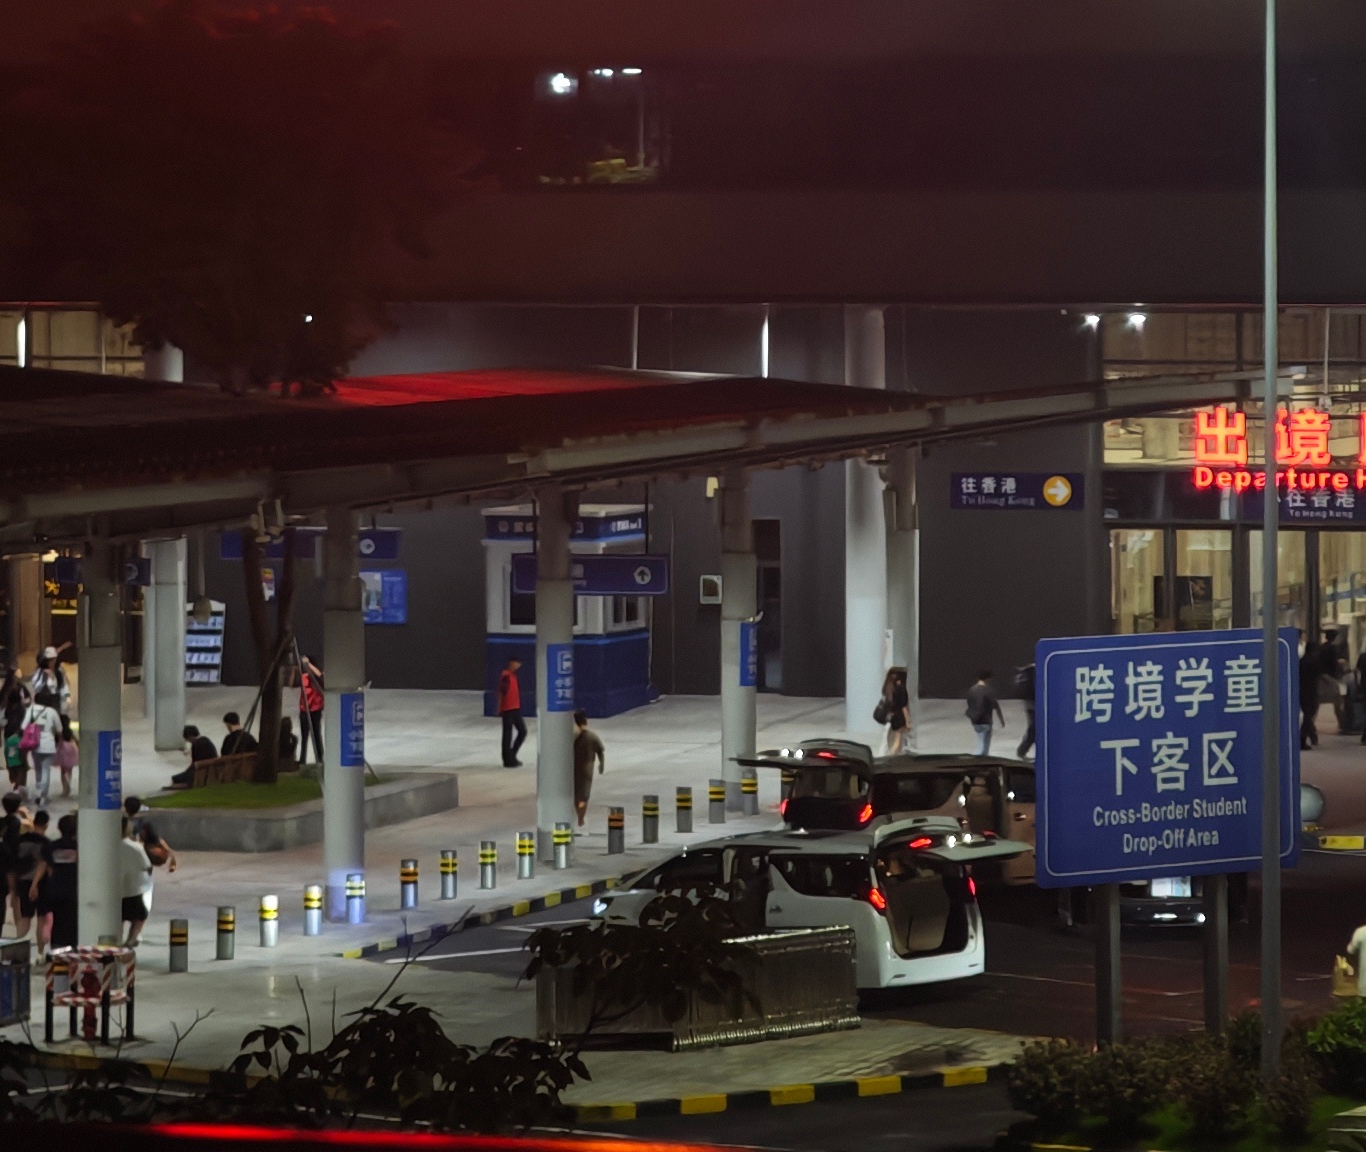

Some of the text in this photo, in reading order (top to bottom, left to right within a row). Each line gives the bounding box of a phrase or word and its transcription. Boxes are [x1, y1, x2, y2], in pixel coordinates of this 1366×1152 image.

[961, 476, 1017, 494] 往香港
[1194, 466, 1349, 493] Departure
[1286, 488, 1355, 508] 往香港
[1074, 654, 1263, 723] 跨境学童
[1100, 731, 1239, 796] 下客区
[1093, 796, 1247, 827] Cross-Border Student
[1122, 827, 1220, 855] Drop-Off Area
